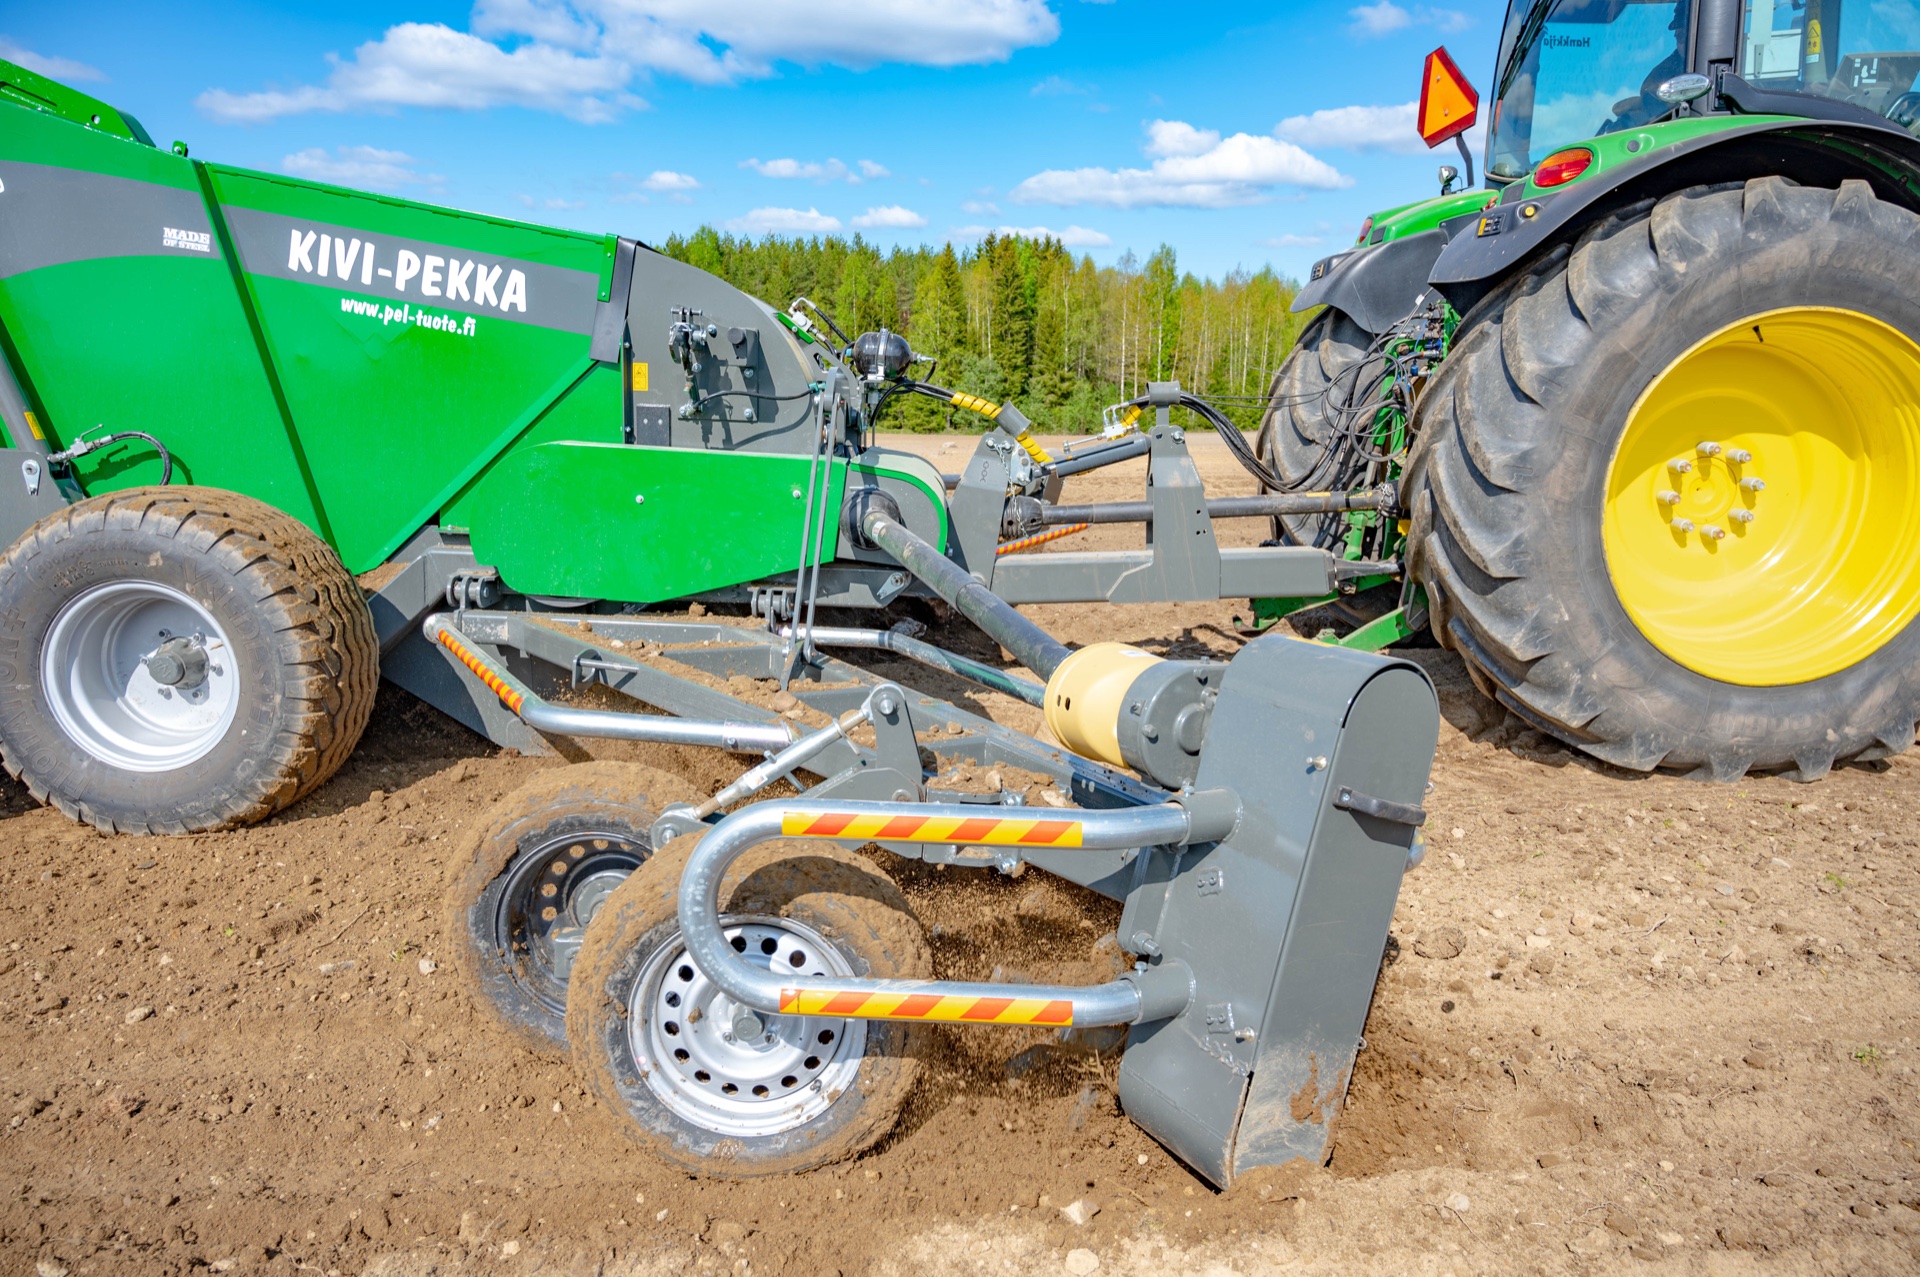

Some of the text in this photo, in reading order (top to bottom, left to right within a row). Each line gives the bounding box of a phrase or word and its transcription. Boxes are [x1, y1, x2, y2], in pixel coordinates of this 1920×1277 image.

[163, 227, 210, 245] MADE
[163, 238, 210, 253] OF STEEL
[287, 228, 527, 313] KIVI-PEKKA
[340, 297, 477, 337] www.pel-tuote.fi
